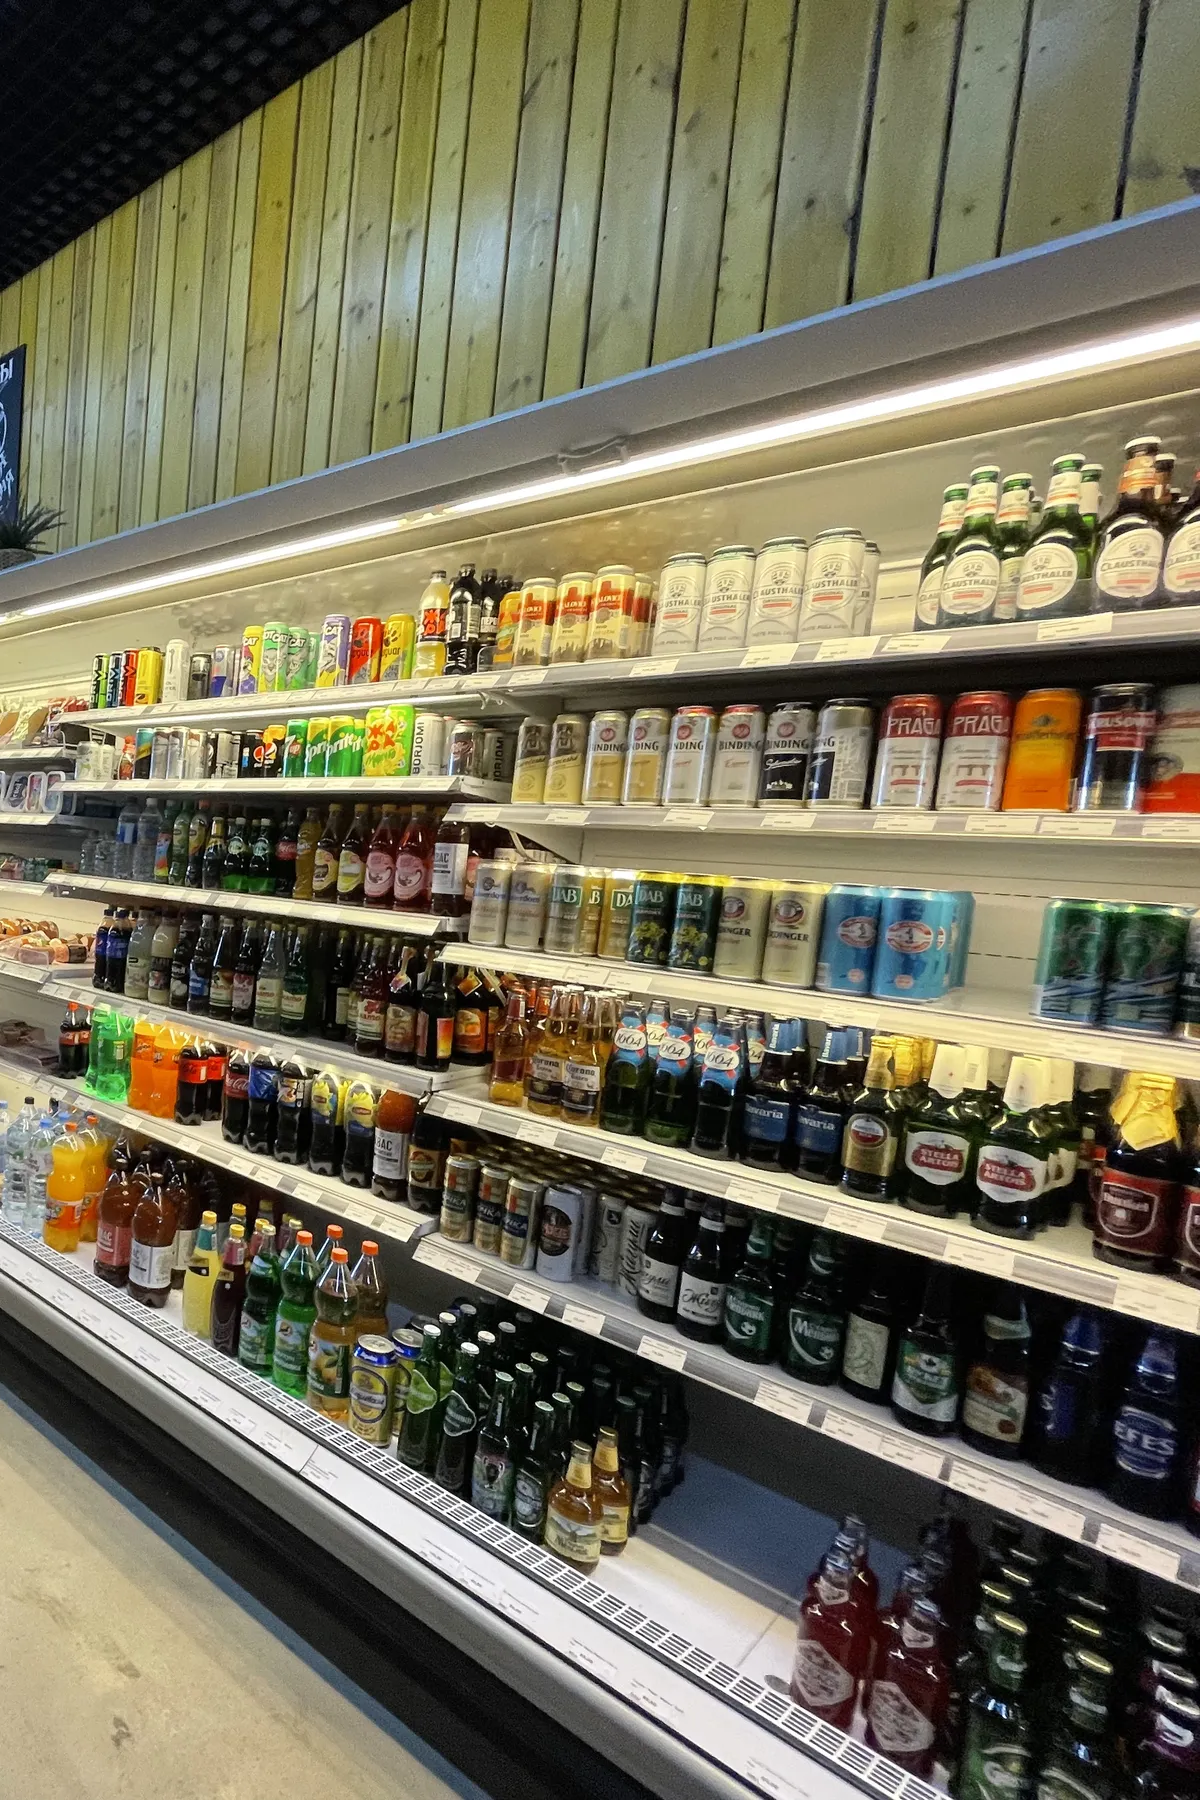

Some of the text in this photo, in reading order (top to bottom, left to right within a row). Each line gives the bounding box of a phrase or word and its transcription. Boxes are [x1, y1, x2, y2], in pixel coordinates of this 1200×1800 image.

[412, 721, 425, 775] BORJOMI
[639, 889, 665, 903] DAB
[680, 892, 703, 907] DAB
[615, 1032, 644, 1048] 1664
[566, 1062, 597, 1077] Corona
[920, 1149, 960, 1161] STELLA
[983, 1162, 1026, 1179] STELLA
[1113, 1419, 1177, 1456] EFES
